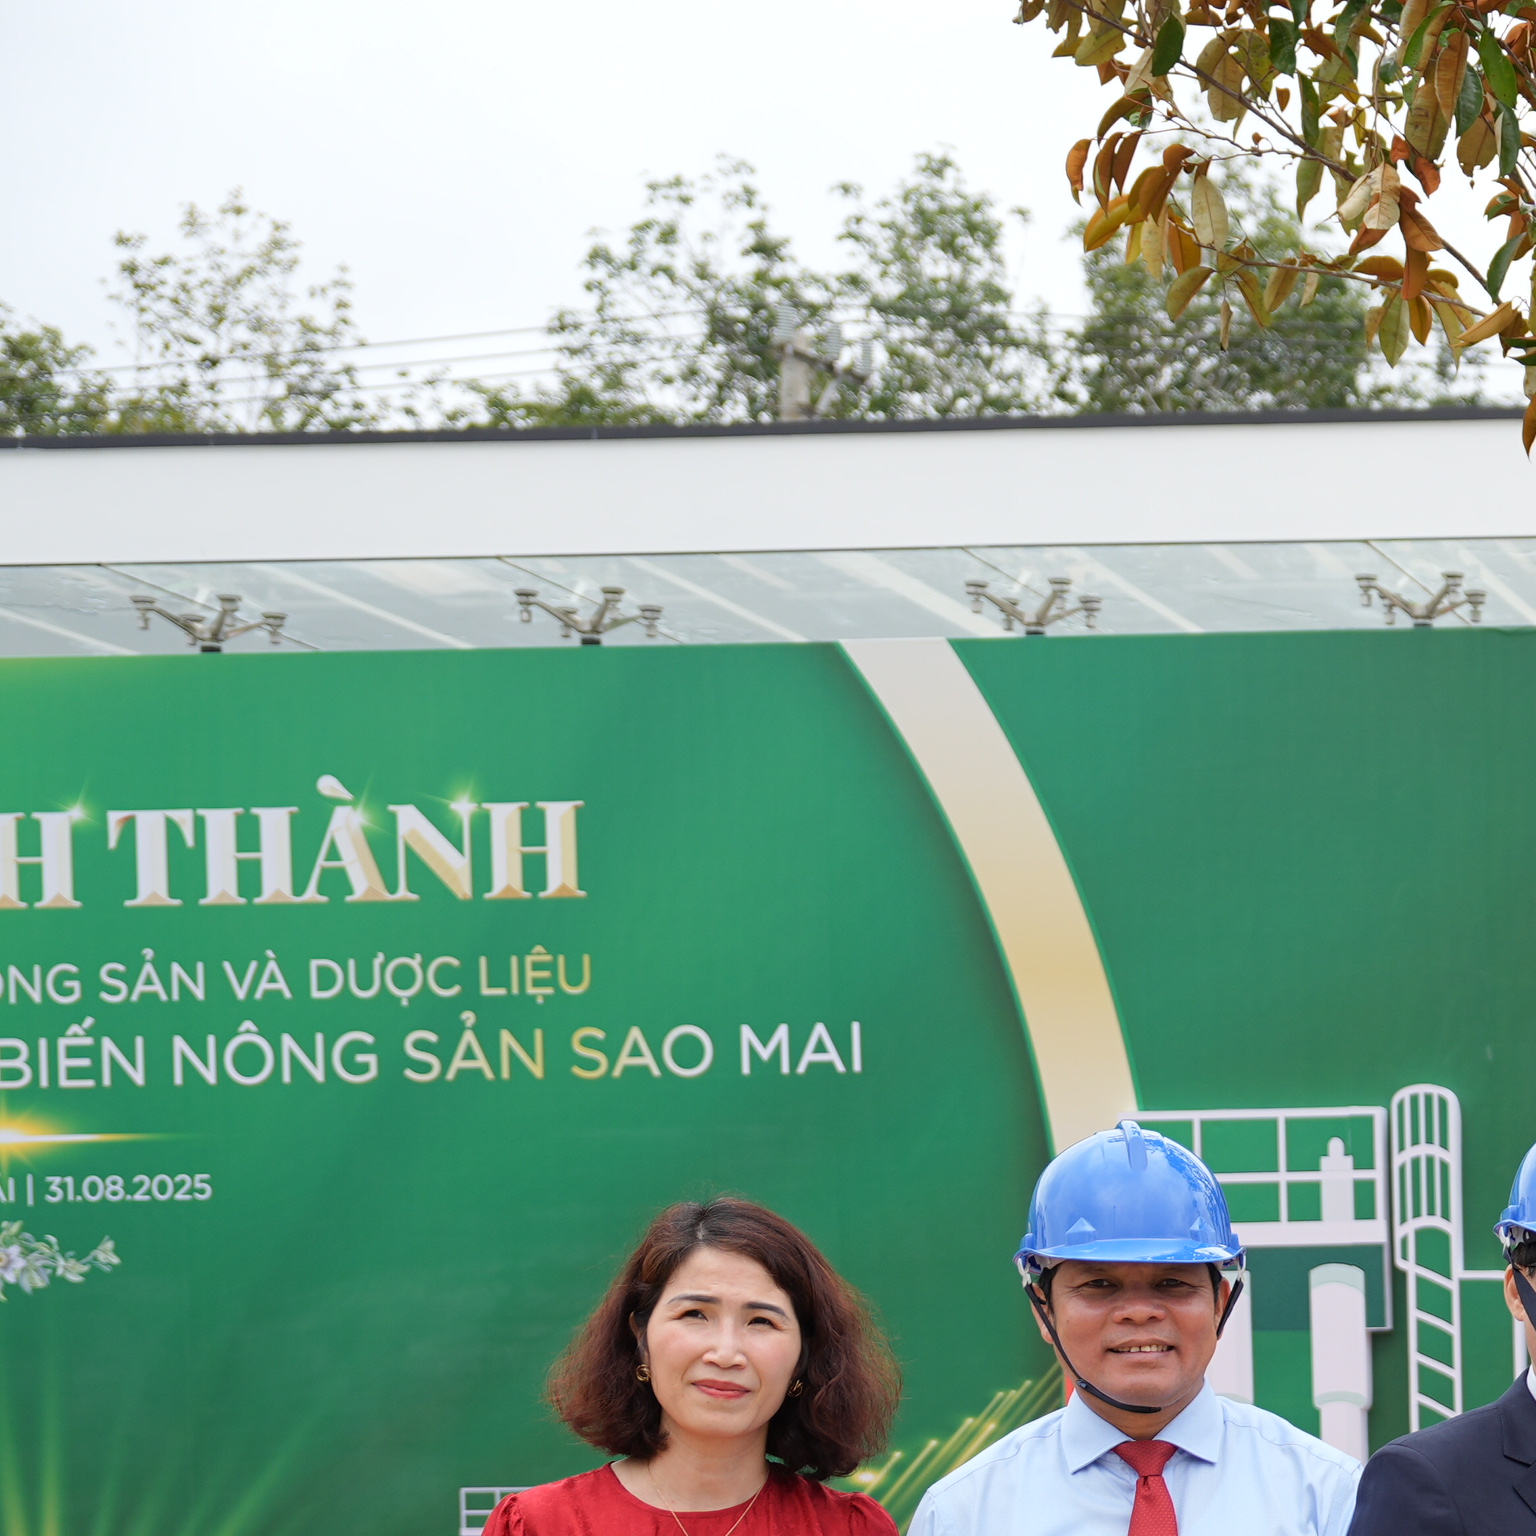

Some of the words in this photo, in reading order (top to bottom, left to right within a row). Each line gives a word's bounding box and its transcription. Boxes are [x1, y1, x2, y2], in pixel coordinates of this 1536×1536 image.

[107, 774, 587, 907] THÀNH
[98, 947, 206, 1004] SẢN
[221, 949, 293, 1001] VÀ
[309, 952, 462, 1005] DƯỢC
[480, 945, 591, 1003] LIỆU
[172, 1019, 379, 1086] NÔNG
[403, 1011, 545, 1082] SẢN
[570, 1022, 714, 1080] SAO
[740, 1020, 863, 1076] MAI
[44, 1173, 213, 1203] 31.08.2025
